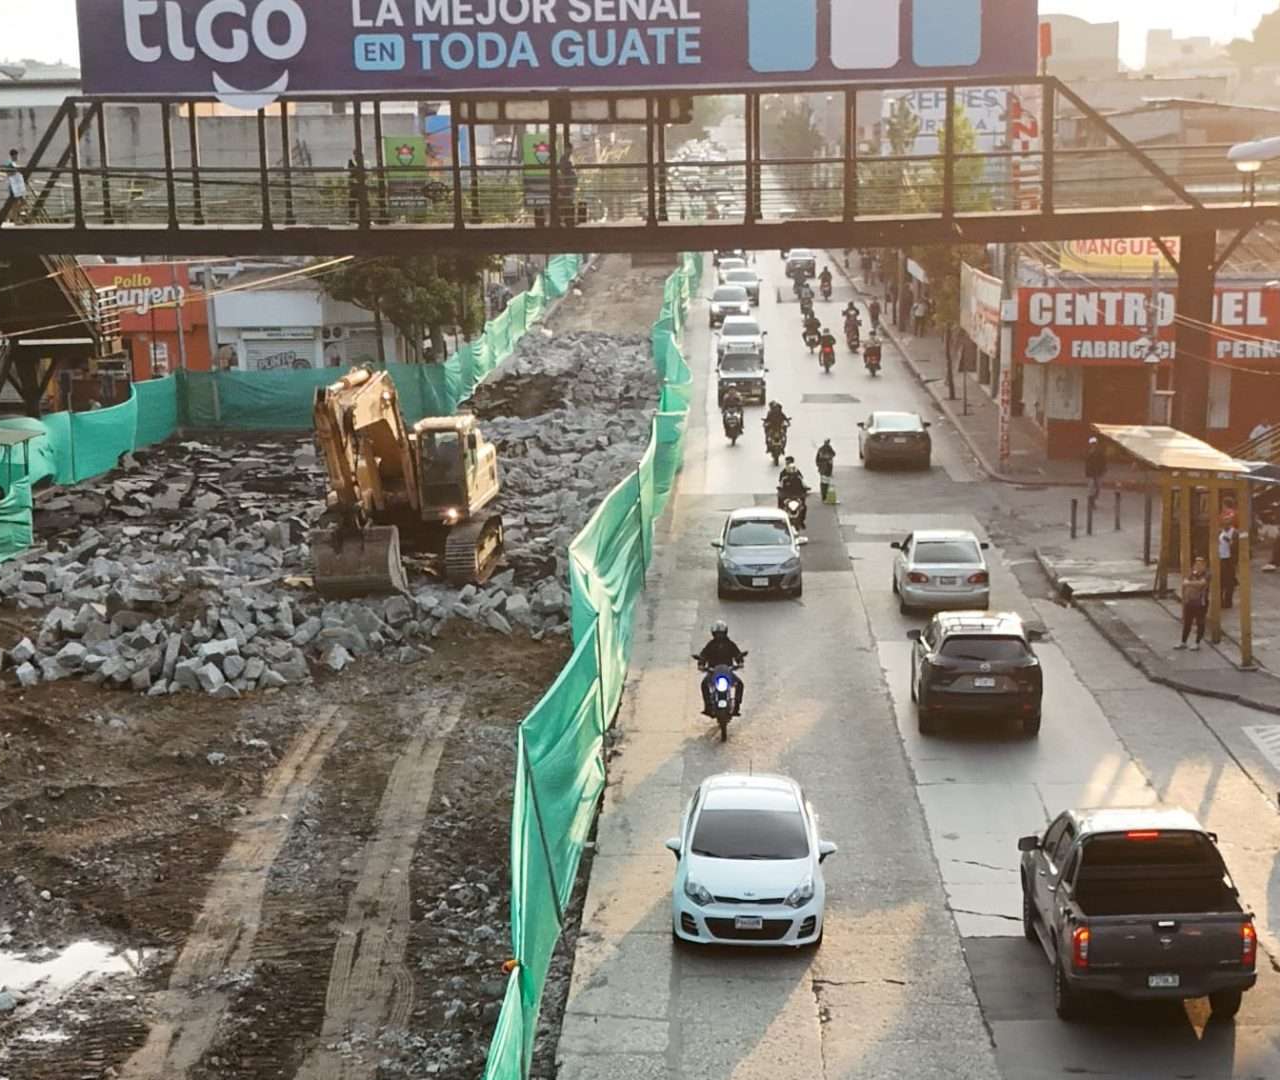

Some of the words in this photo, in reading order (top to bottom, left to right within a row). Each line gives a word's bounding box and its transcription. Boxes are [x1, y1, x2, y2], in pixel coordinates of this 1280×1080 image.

[352, 0, 404, 27] LA
[415, 0, 556, 26] MEJOR
[364, 42, 396, 62] EN
[412, 31, 539, 70] TODA
[551, 27, 701, 67] GUATE
[113, 274, 152, 288] Pollo
[1029, 291, 1176, 326] CENTRO
[1212, 290, 1268, 326] EL
